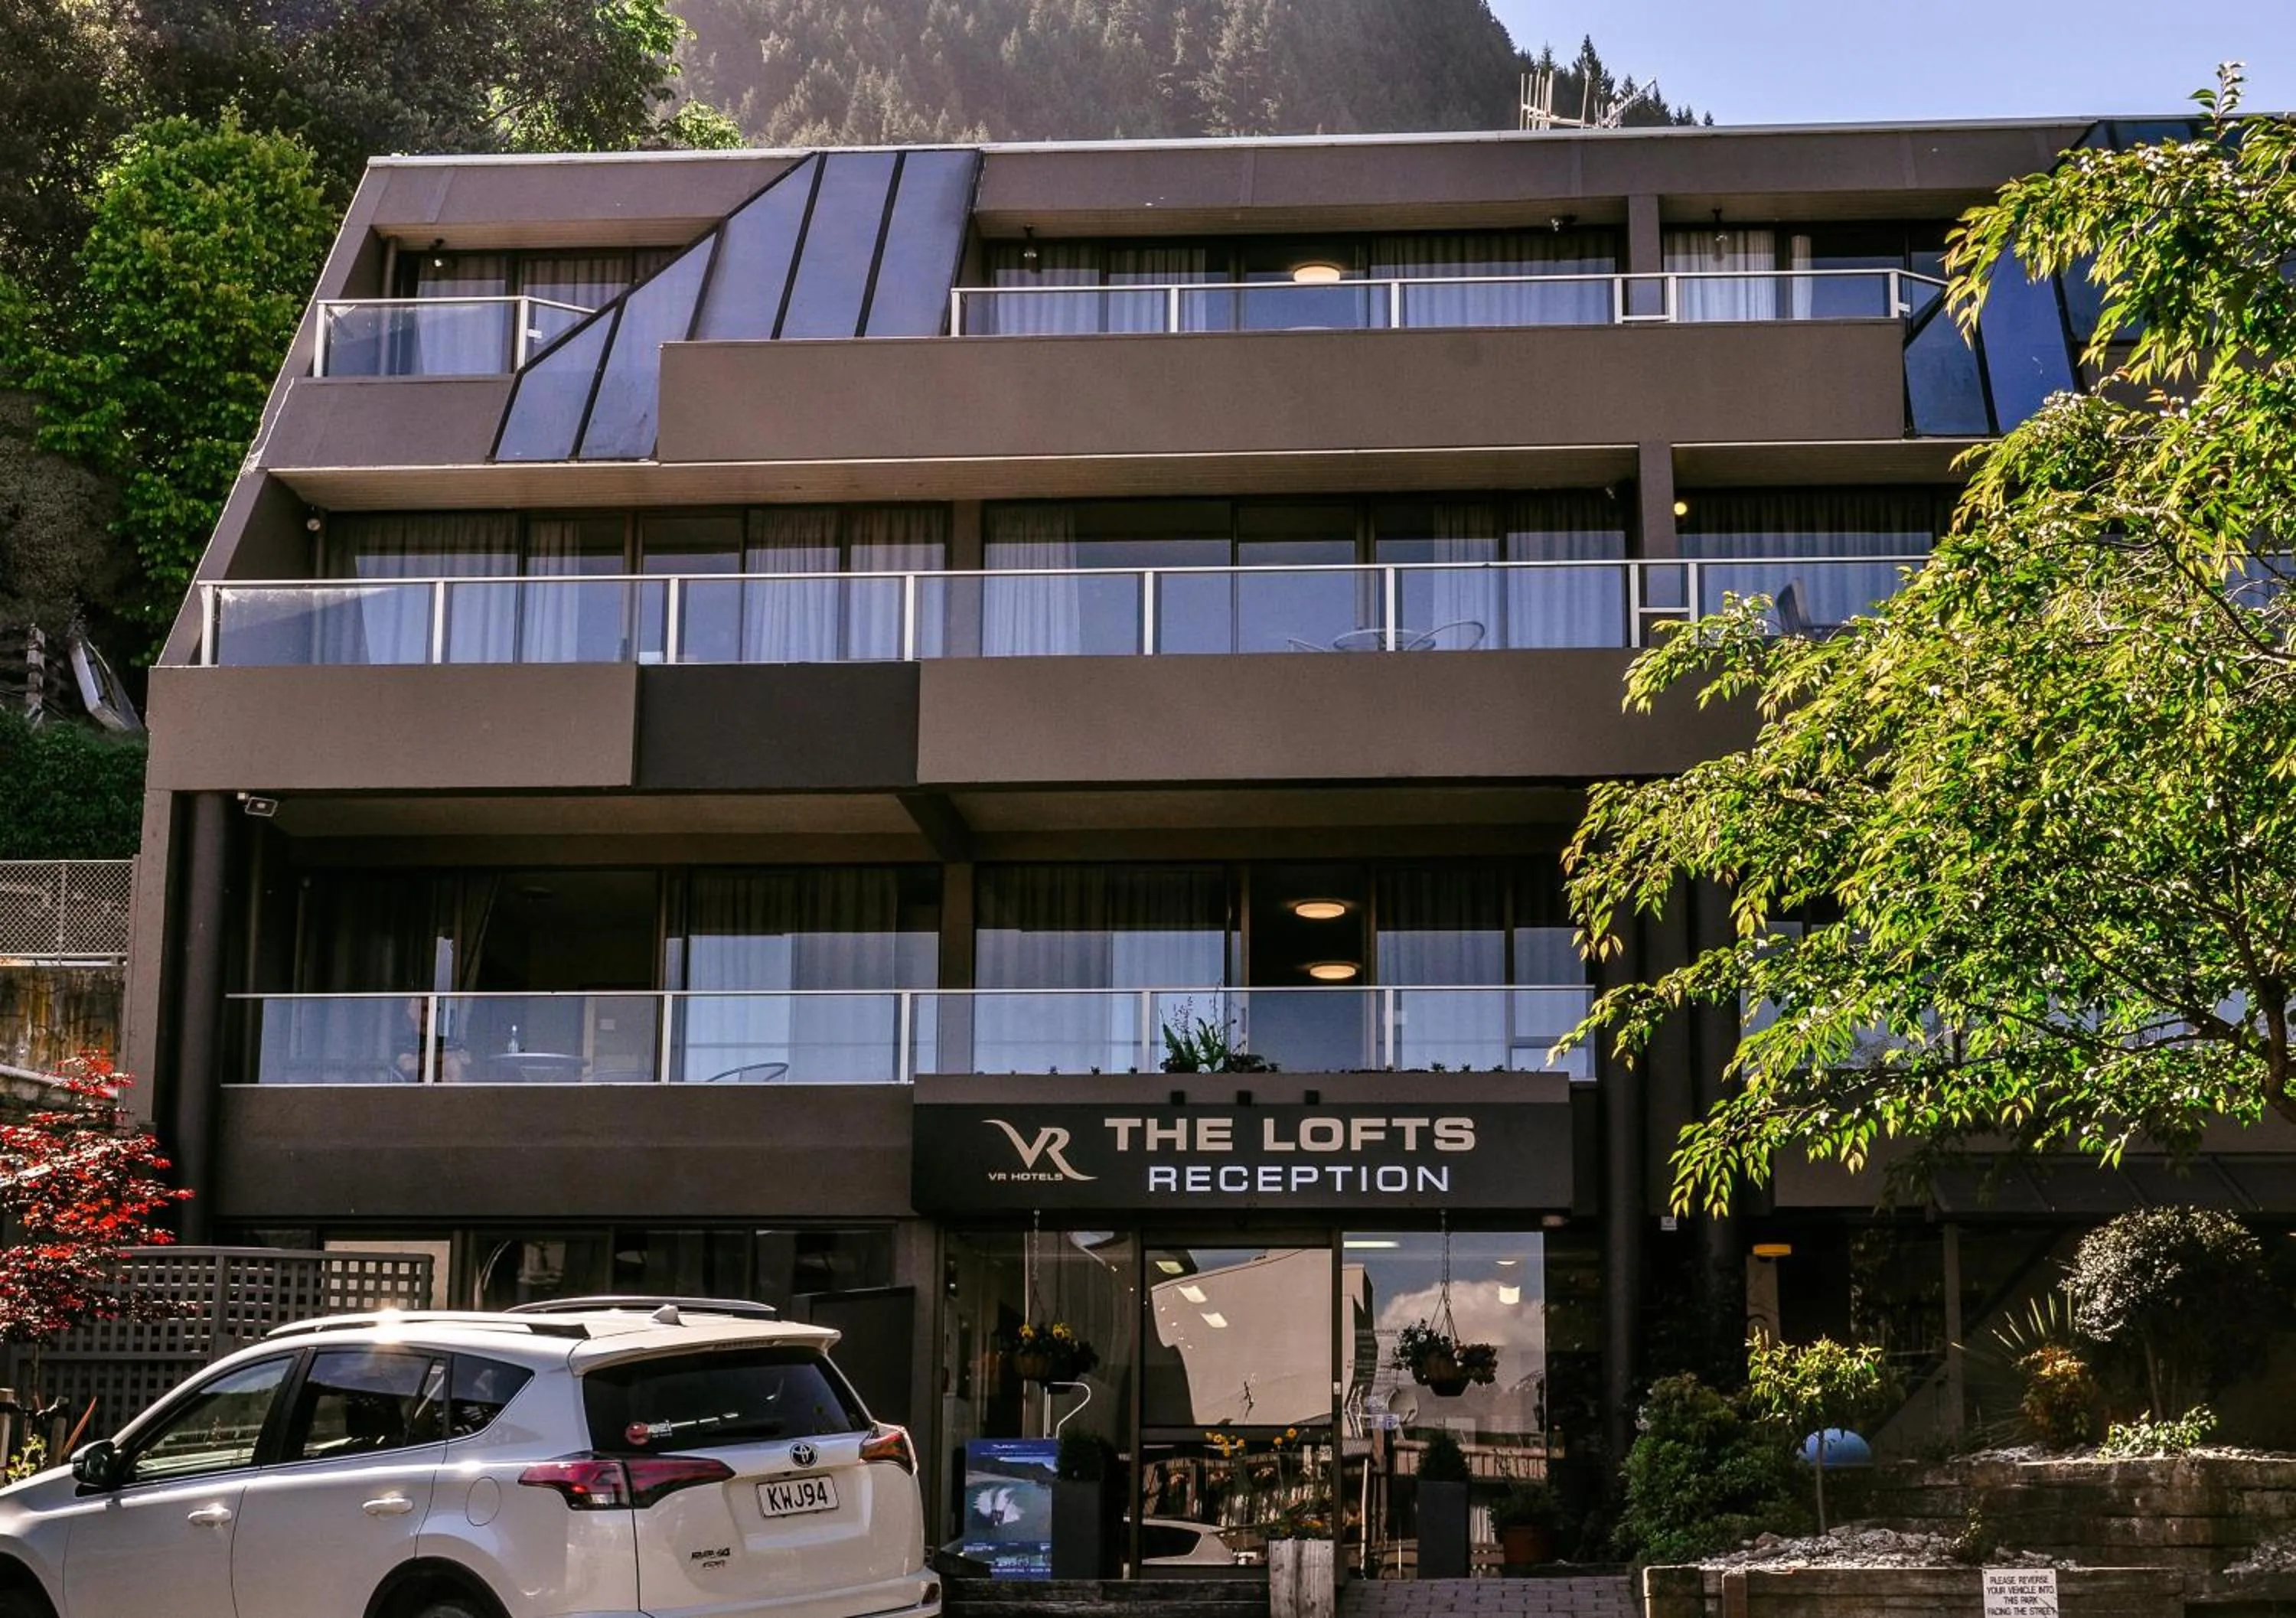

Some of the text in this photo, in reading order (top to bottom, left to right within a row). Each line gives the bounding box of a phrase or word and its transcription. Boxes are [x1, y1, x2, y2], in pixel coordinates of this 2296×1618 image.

[1104, 1117, 1476, 1152] THE LOFTS
[980, 1119, 1098, 1181] VR
[988, 1173, 1063, 1181] VR HOTELS
[1148, 1166, 1449, 1192] RECEPTION
[767, 1481, 827, 1511] KWJ94
[1990, 1575, 2048, 1584] PLEASE REVERSE
[1987, 1585, 2054, 1594] YOUR VEHICLE INTO
[2004, 1596, 2038, 1604] THIS PARK
[1987, 1607, 2056, 1616] FACING THE STREET
